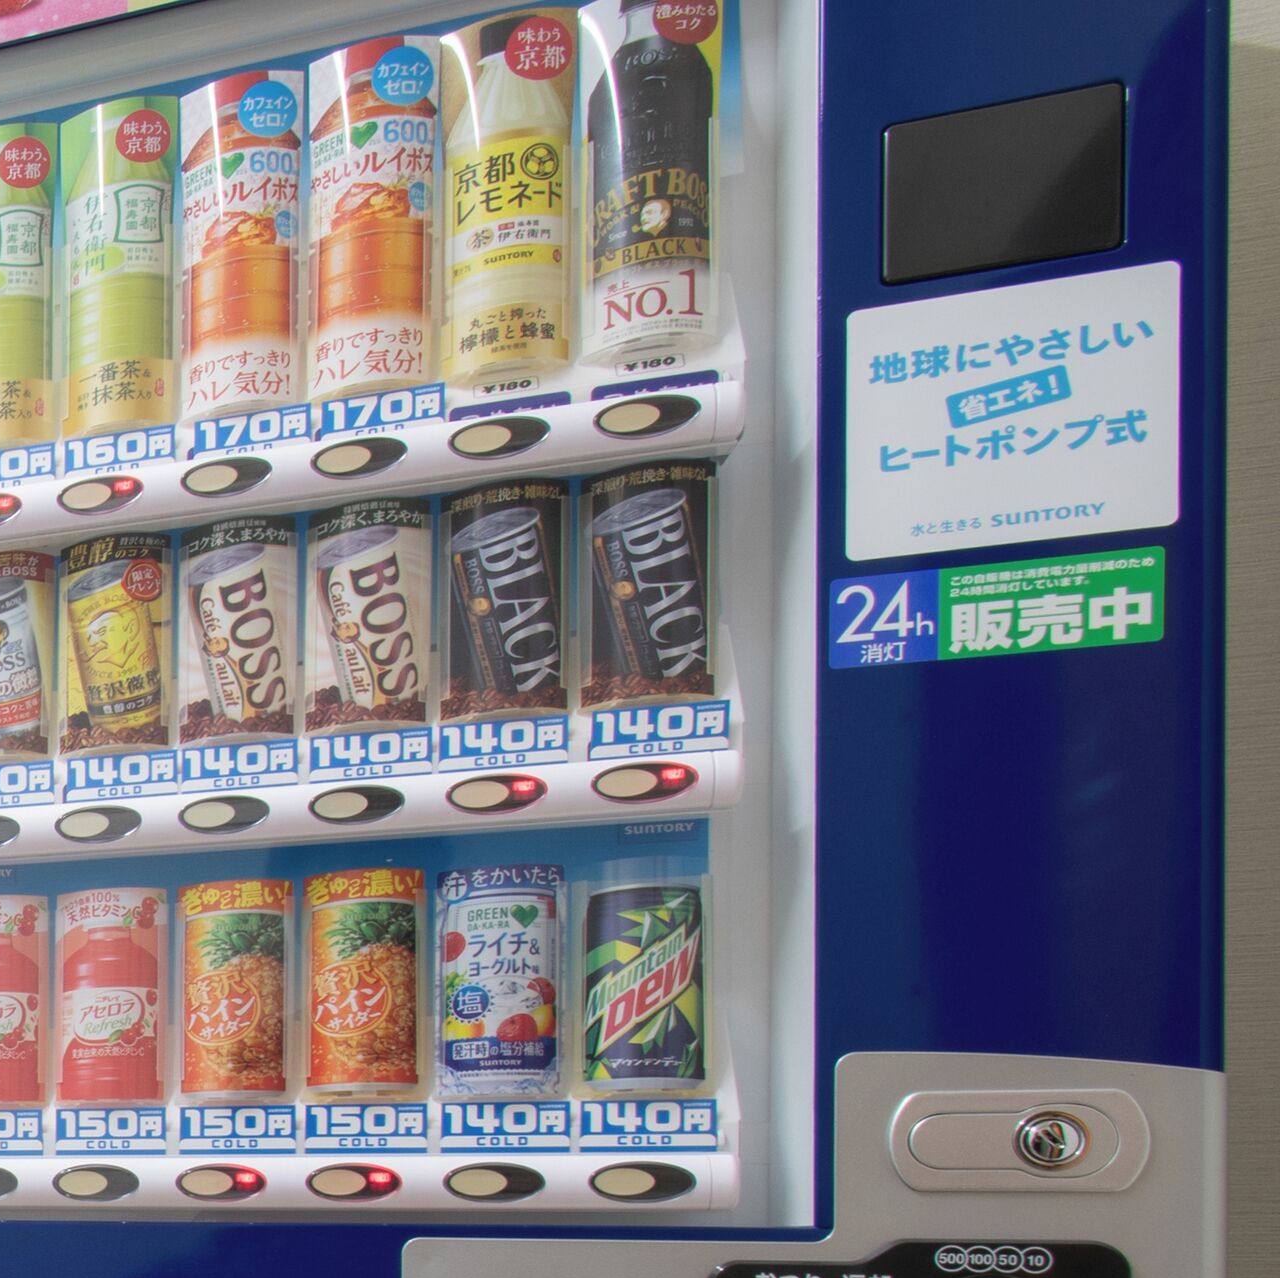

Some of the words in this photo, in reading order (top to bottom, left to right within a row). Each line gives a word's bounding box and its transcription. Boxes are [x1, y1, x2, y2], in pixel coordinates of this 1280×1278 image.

[378, 61, 429, 80] カフェイン
[516, 46, 566, 71] 京都
[384, 79, 424, 97] ゼロ!
[383, 120, 428, 145] 600
[7, 162, 41, 180] 京都
[455, 151, 515, 197] 京都
[456, 181, 563, 227] レモネード
[483, 250, 534, 265] SUNTORY
[622, 236, 687, 265] BLACK
[603, 269, 703, 331] NO.1
[315, 326, 424, 364] 香りですっきり
[868, 320, 1155, 385] 地球にやさしい
[312, 350, 424, 390] ハレ気分!
[328, 389, 440, 432] 170円
[958, 373, 1060, 422] 省エネ!
[879, 408, 1148, 473] ヒートポンプ式
[910, 517, 983, 537] 水と生きる
[991, 502, 1106, 528] SUNTORY
[950, 556, 1156, 587] この自販機は消費電力量削減のため
[620, 507, 707, 679] BLACK
[349, 551, 419, 697] BOSS
[948, 586, 1154, 654] 販売中
[860, 641, 907, 665] 消灯
[443, 721, 565, 757] 140円
[596, 705, 727, 744] 140円
[467, 906, 509, 922] GREEN
[467, 932, 541, 958] ライチ&
[80, 999, 136, 1024] アセロラ
[314, 986, 386, 1023] パイン
[455, 991, 483, 1014] 塩
[82, 1014, 132, 1036] Refresh
[327, 1007, 382, 1031] サイダー
[479, 1058, 523, 1067] SUNTORY
[183, 1107, 292, 1137] 150円
[444, 1104, 566, 1134] 140円
[584, 1101, 712, 1133] 140円
[211, 1138, 258, 1149] COLD
[476, 1135, 529, 1147] COLD
[617, 1134, 672, 1146] COLD
[939, 1253, 965, 1265] 500
[969, 1253, 992, 1265] 100
[998, 1254, 1018, 1266] 50
[1027, 1254, 1045, 1267] 10
